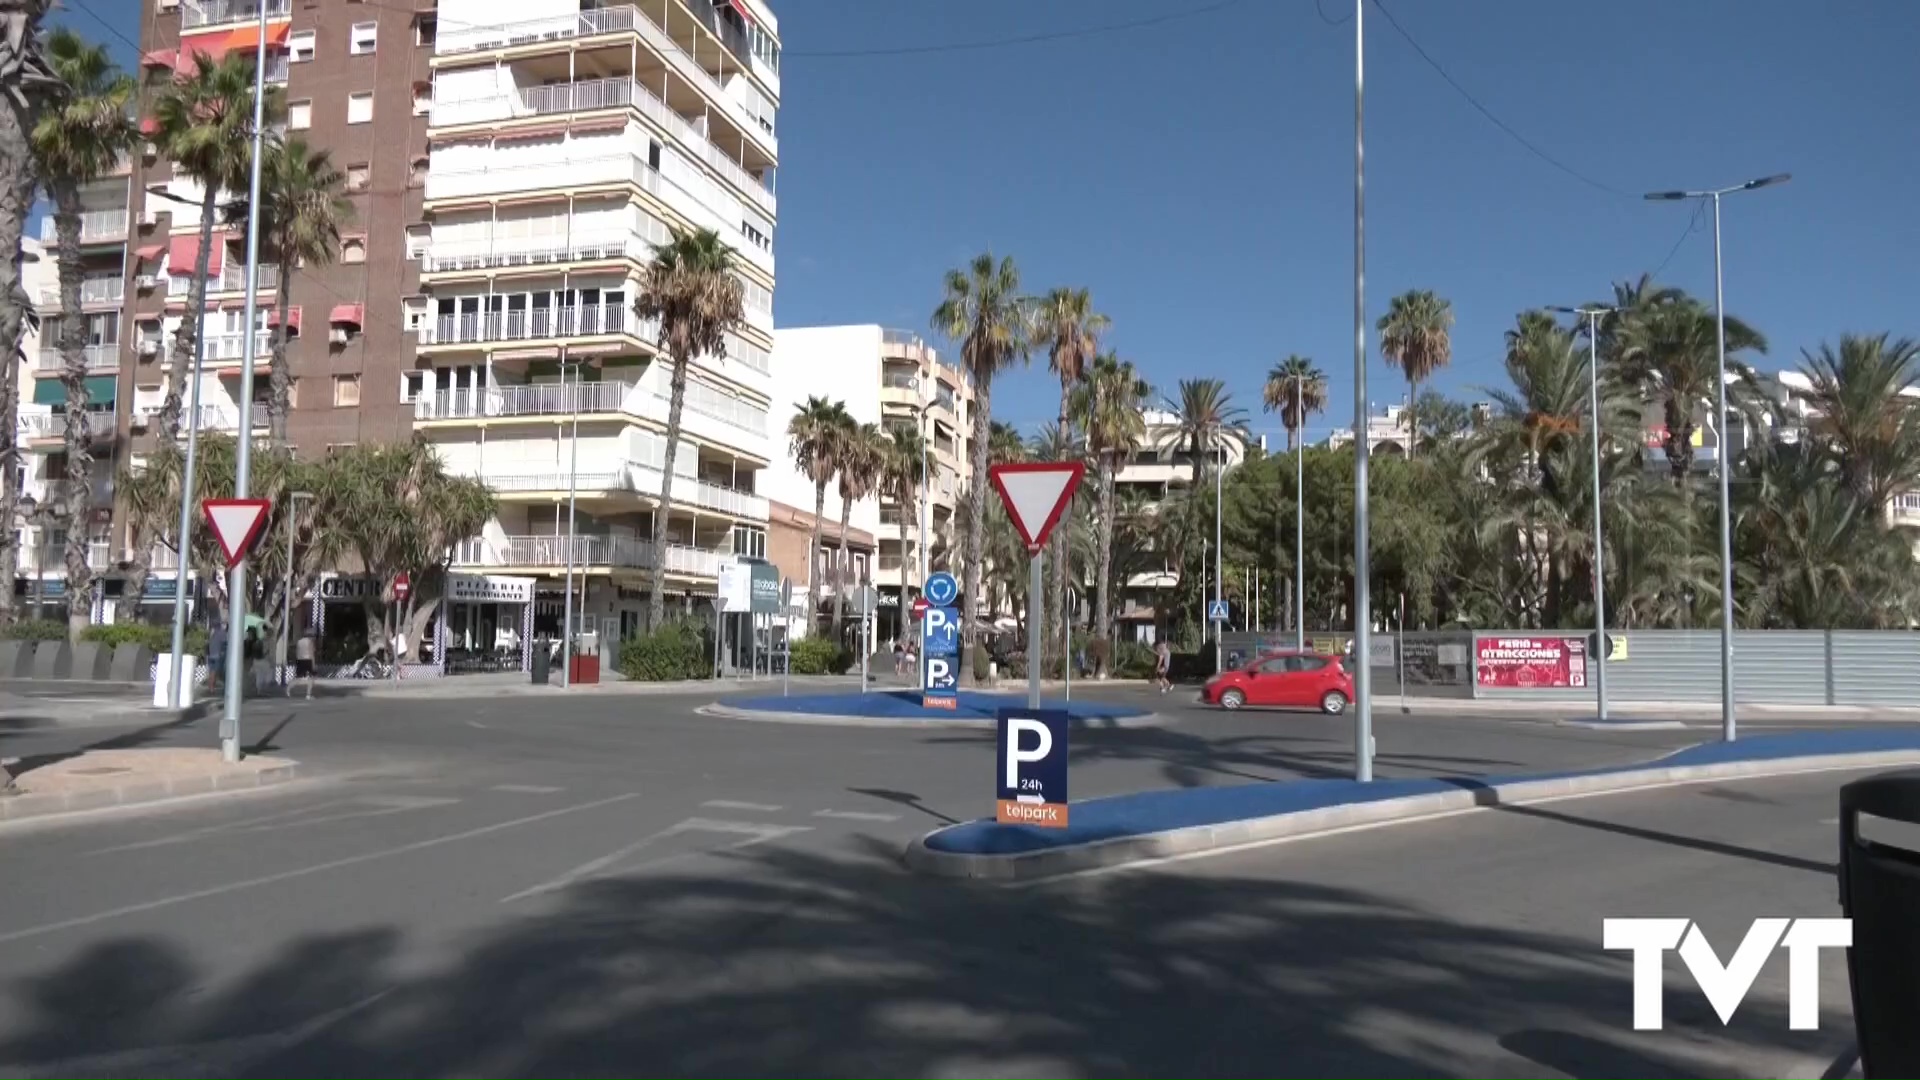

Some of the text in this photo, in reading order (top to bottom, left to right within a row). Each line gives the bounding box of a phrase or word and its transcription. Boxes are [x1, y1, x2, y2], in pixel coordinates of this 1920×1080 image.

[456, 581, 523, 591] PIZZERIA
[927, 609, 945, 637] P
[1481, 649, 1561, 658] ATRACCIONES
[928, 659, 949, 688] P
[1006, 718, 1053, 789] P
[1021, 779, 1043, 790] 24h
[1006, 804, 1057, 820] telpark
